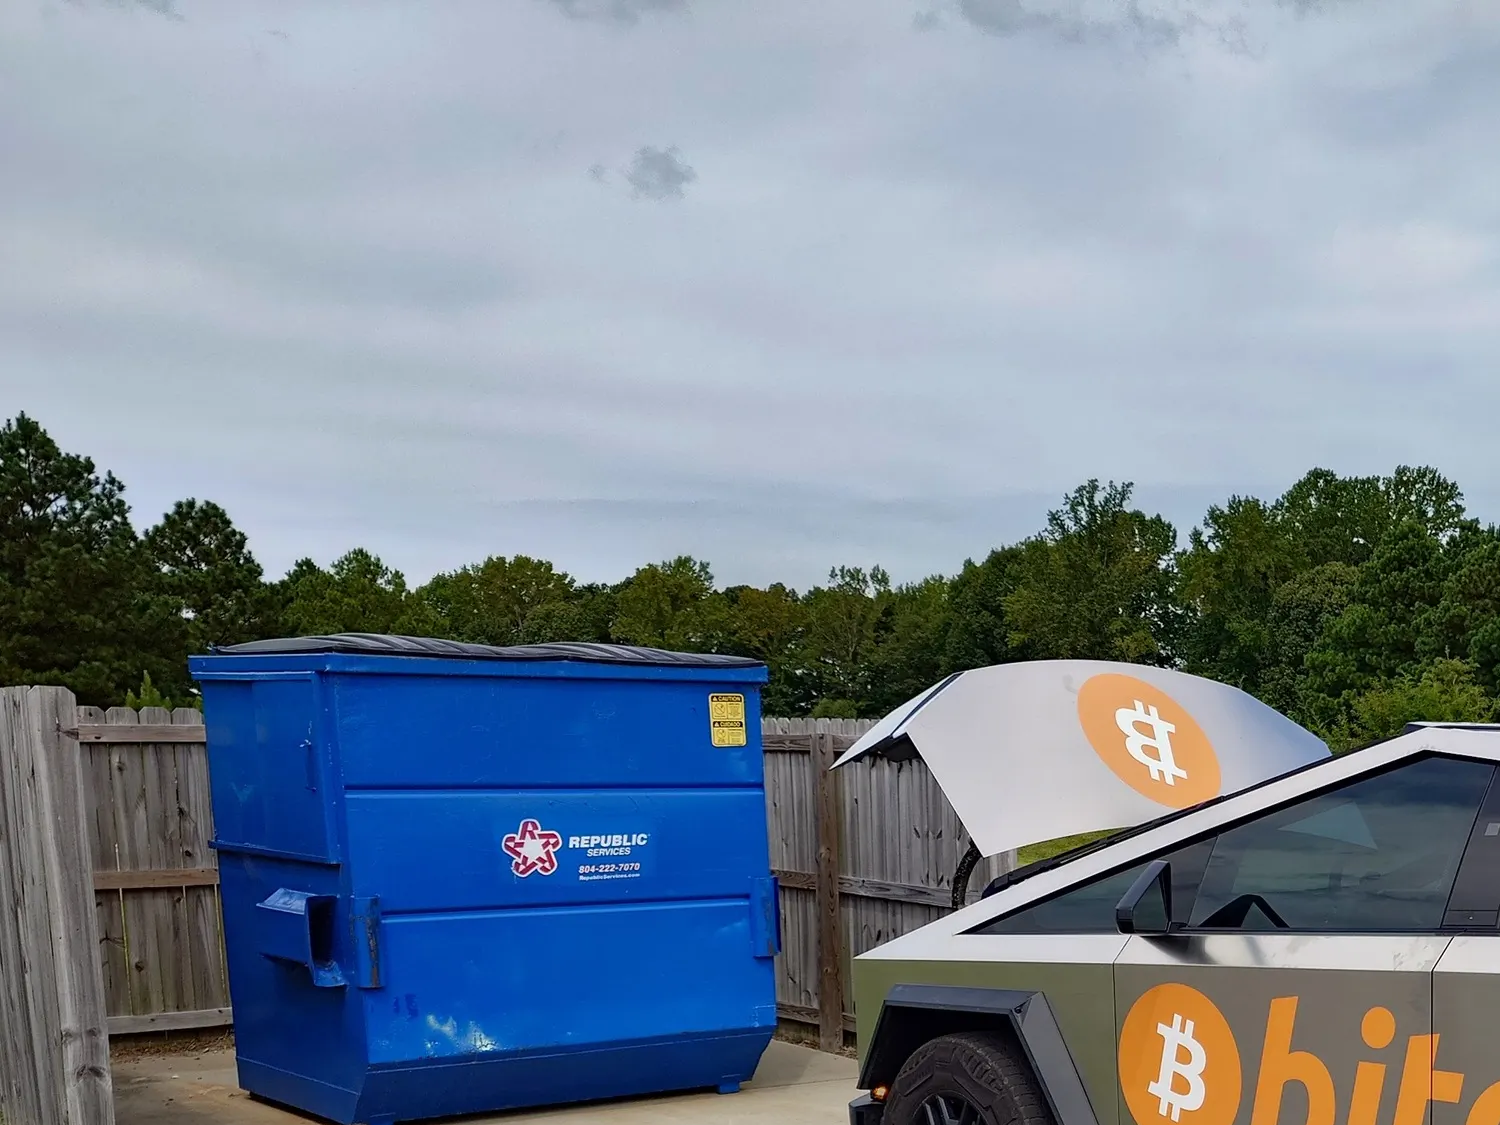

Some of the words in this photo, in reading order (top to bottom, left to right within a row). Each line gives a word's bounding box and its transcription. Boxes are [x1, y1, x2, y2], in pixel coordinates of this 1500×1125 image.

[568, 833, 648, 849] REPUBLIC
[586, 847, 631, 857] SERVICES
[578, 862, 641, 874] 804-222-7070
[578, 873, 641, 881] RepublicServices.com
